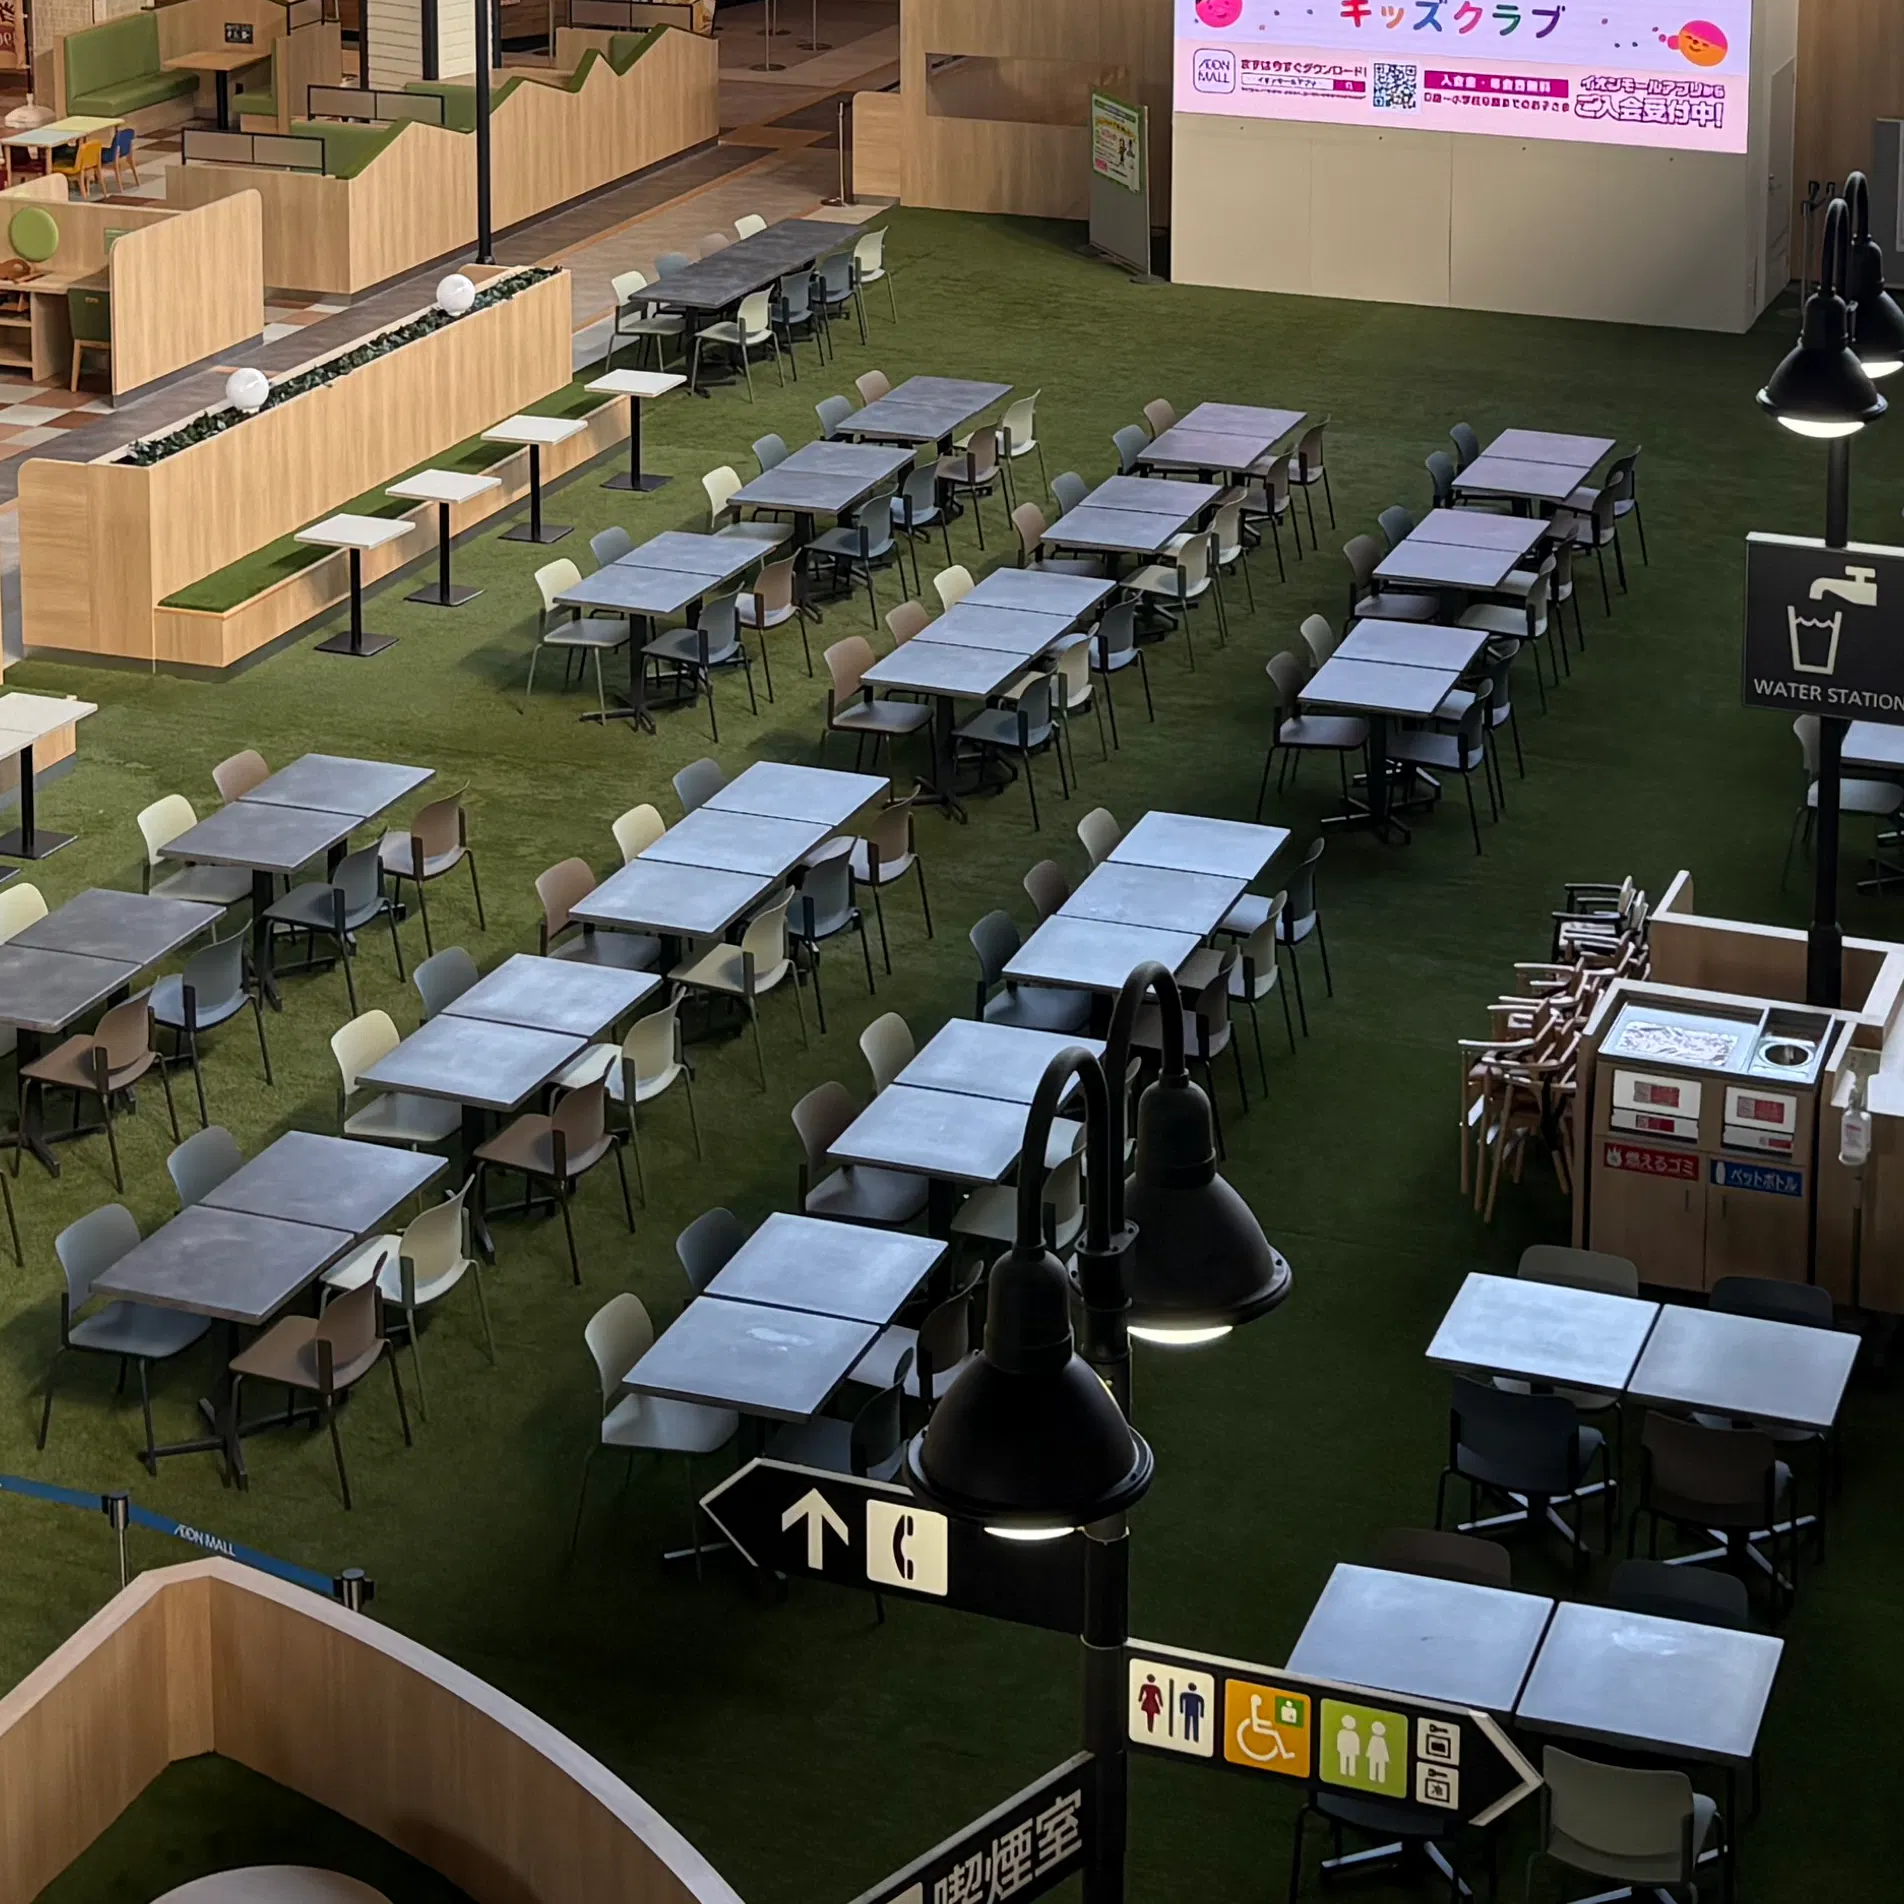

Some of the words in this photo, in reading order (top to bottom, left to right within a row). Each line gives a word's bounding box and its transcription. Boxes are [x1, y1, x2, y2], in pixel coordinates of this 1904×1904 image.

[1198, 70, 1231, 84] MALL
[1754, 678, 1821, 701] WATER
[1625, 1150, 1695, 1177] 燃えるゴミ
[1730, 1168, 1796, 1192] ペットボトル
[203, 1535, 237, 1557] MALL
[933, 1788, 1083, 1904] 喫煙室
